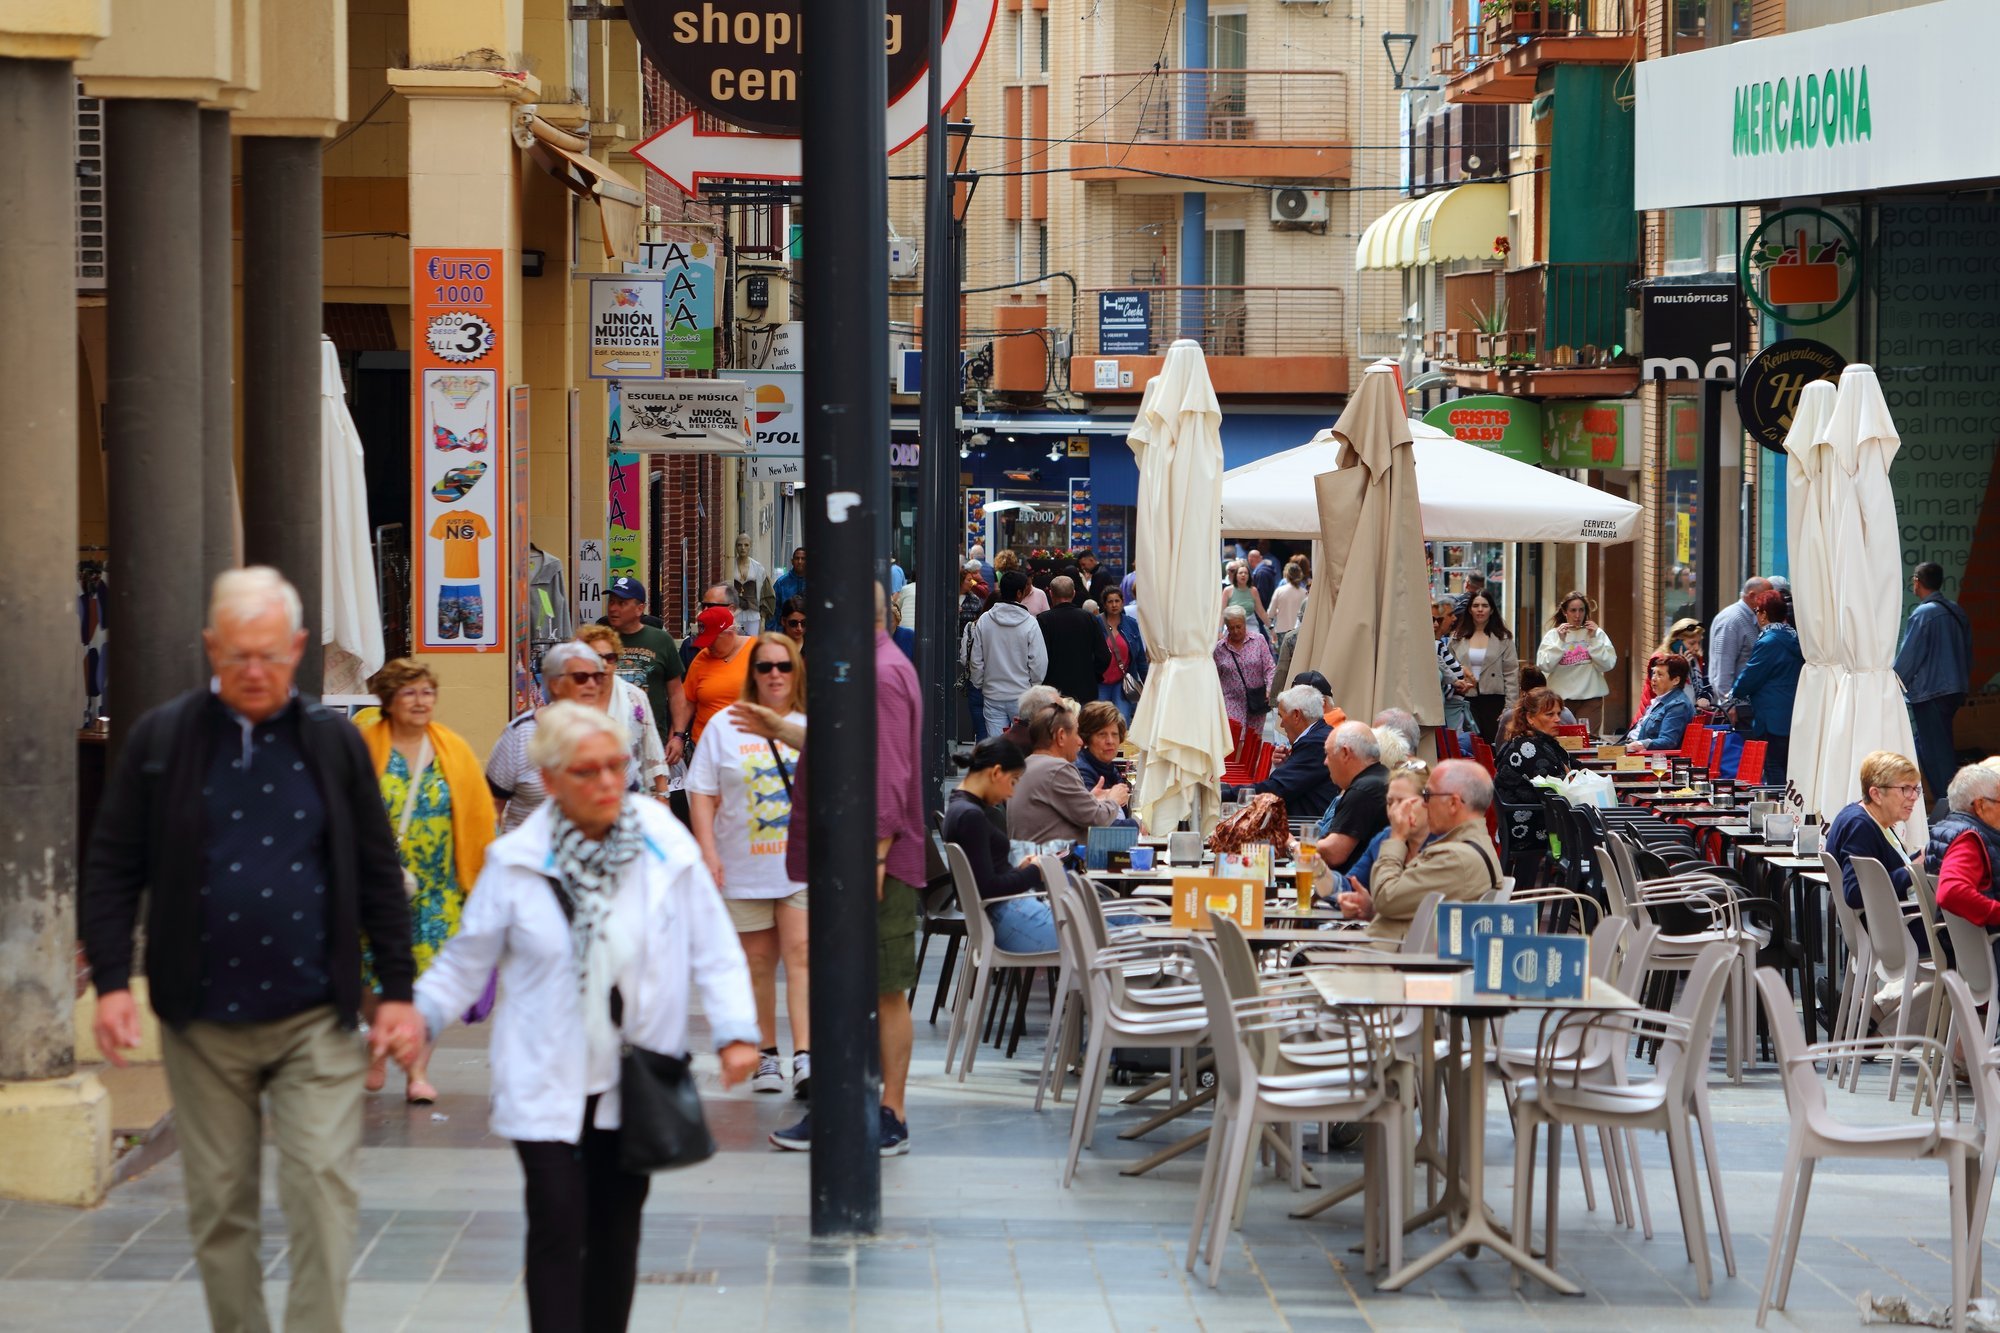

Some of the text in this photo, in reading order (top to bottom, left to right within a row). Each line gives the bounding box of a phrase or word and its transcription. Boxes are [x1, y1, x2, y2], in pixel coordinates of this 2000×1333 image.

[672, 2, 902, 54] shopg
[710, 67, 797, 101] cen
[1733, 64, 1872, 158] MERCADONA
[435, 286, 483, 302] 1000
[602, 311, 653, 325] UNIÓN
[596, 326, 659, 338] MUSICAL
[596, 338, 659, 346] BENIDORM
[627, 393, 675, 401] ESCUELA
[697, 393, 739, 401] MÚSICA
[692, 408, 731, 417] UNIÓN
[689, 417, 738, 425] MUSICAL
[756, 432, 800, 444] PSOL
[1454, 427, 1504, 441] BABY
[768, 462, 798, 476] New York
[1583, 519, 1616, 529] CERVEZAS
[1580, 528, 1617, 538] ALHAMBRA
